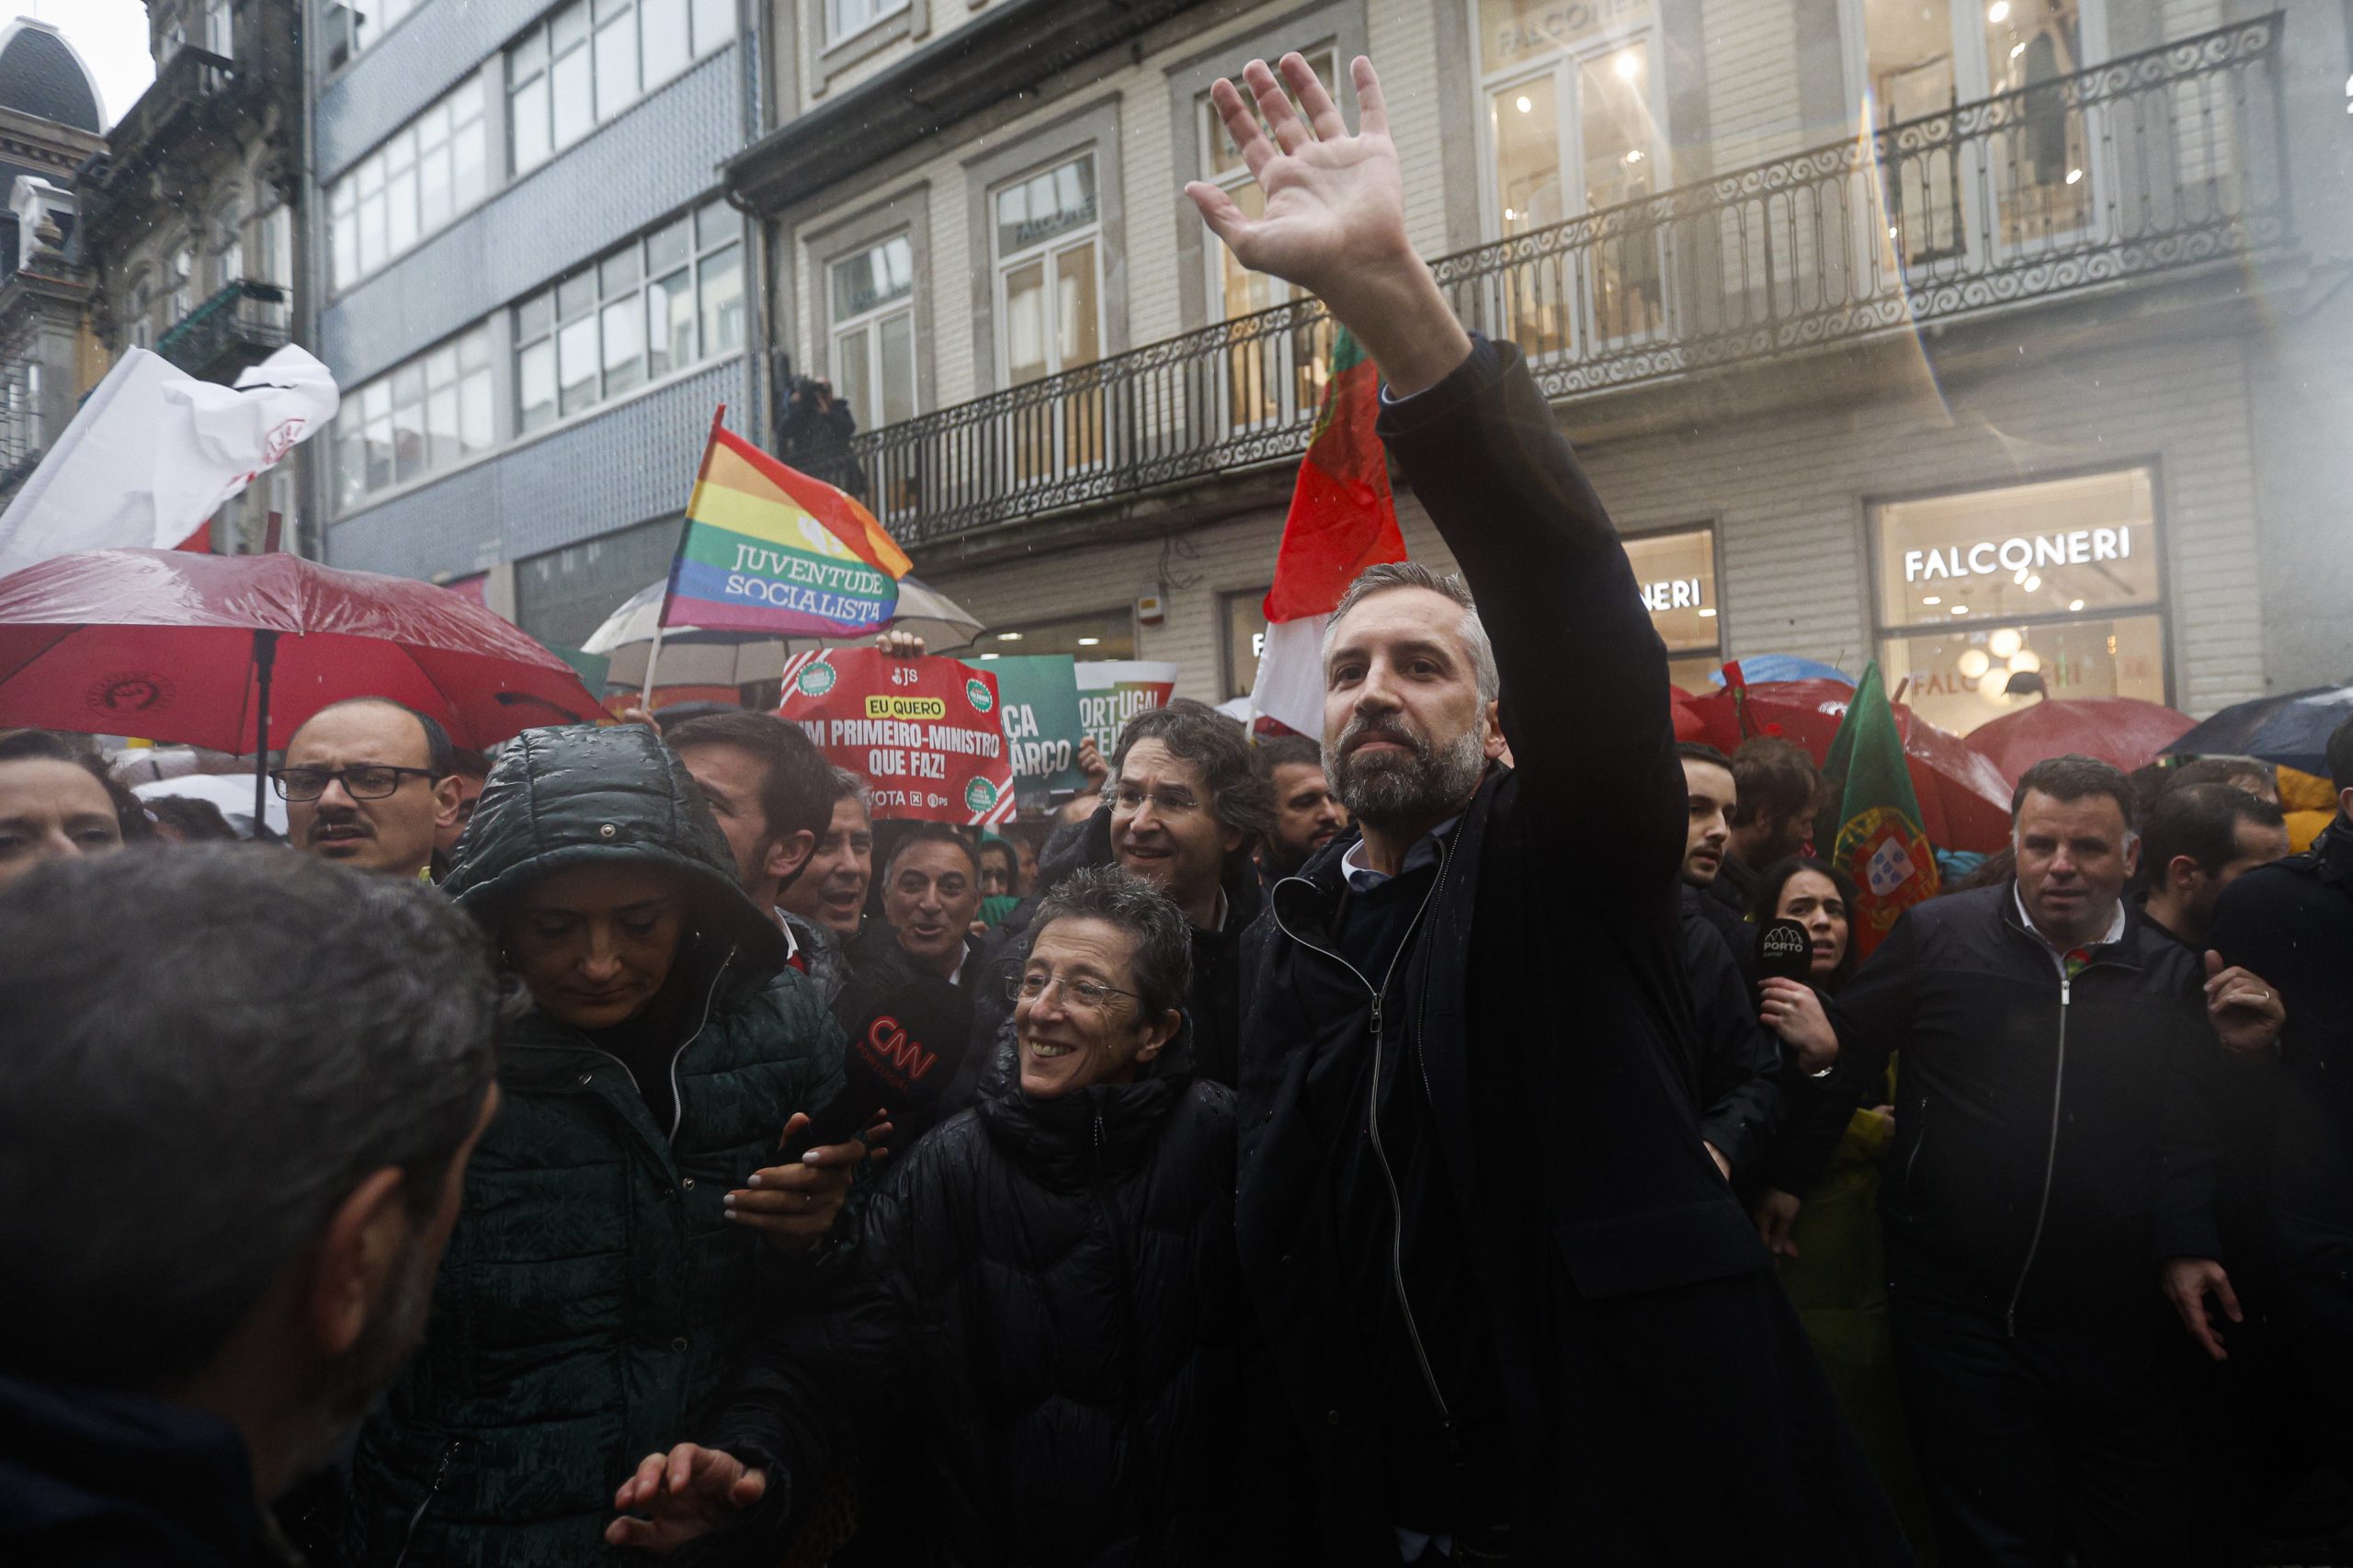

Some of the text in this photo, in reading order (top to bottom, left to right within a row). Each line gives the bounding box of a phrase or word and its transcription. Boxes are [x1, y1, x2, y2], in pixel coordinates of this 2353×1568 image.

[731, 543, 883, 595] JUVENTUDE
[1904, 525, 2131, 583] FALCONERI
[725, 574, 881, 622] SOCIALISTA
[1639, 577, 1700, 612] NERI
[903, 667, 918, 687] JS
[870, 699, 941, 715] EU QUERO
[1001, 704, 1040, 744] ÇA
[831, 720, 1000, 759] PRIMEIRO-MINISTRO
[1010, 739, 1072, 779] ARÇO
[869, 749, 945, 779] QUE FAZ!
[1763, 941, 1803, 952] PORTO
[869, 1016, 939, 1081] CNN
